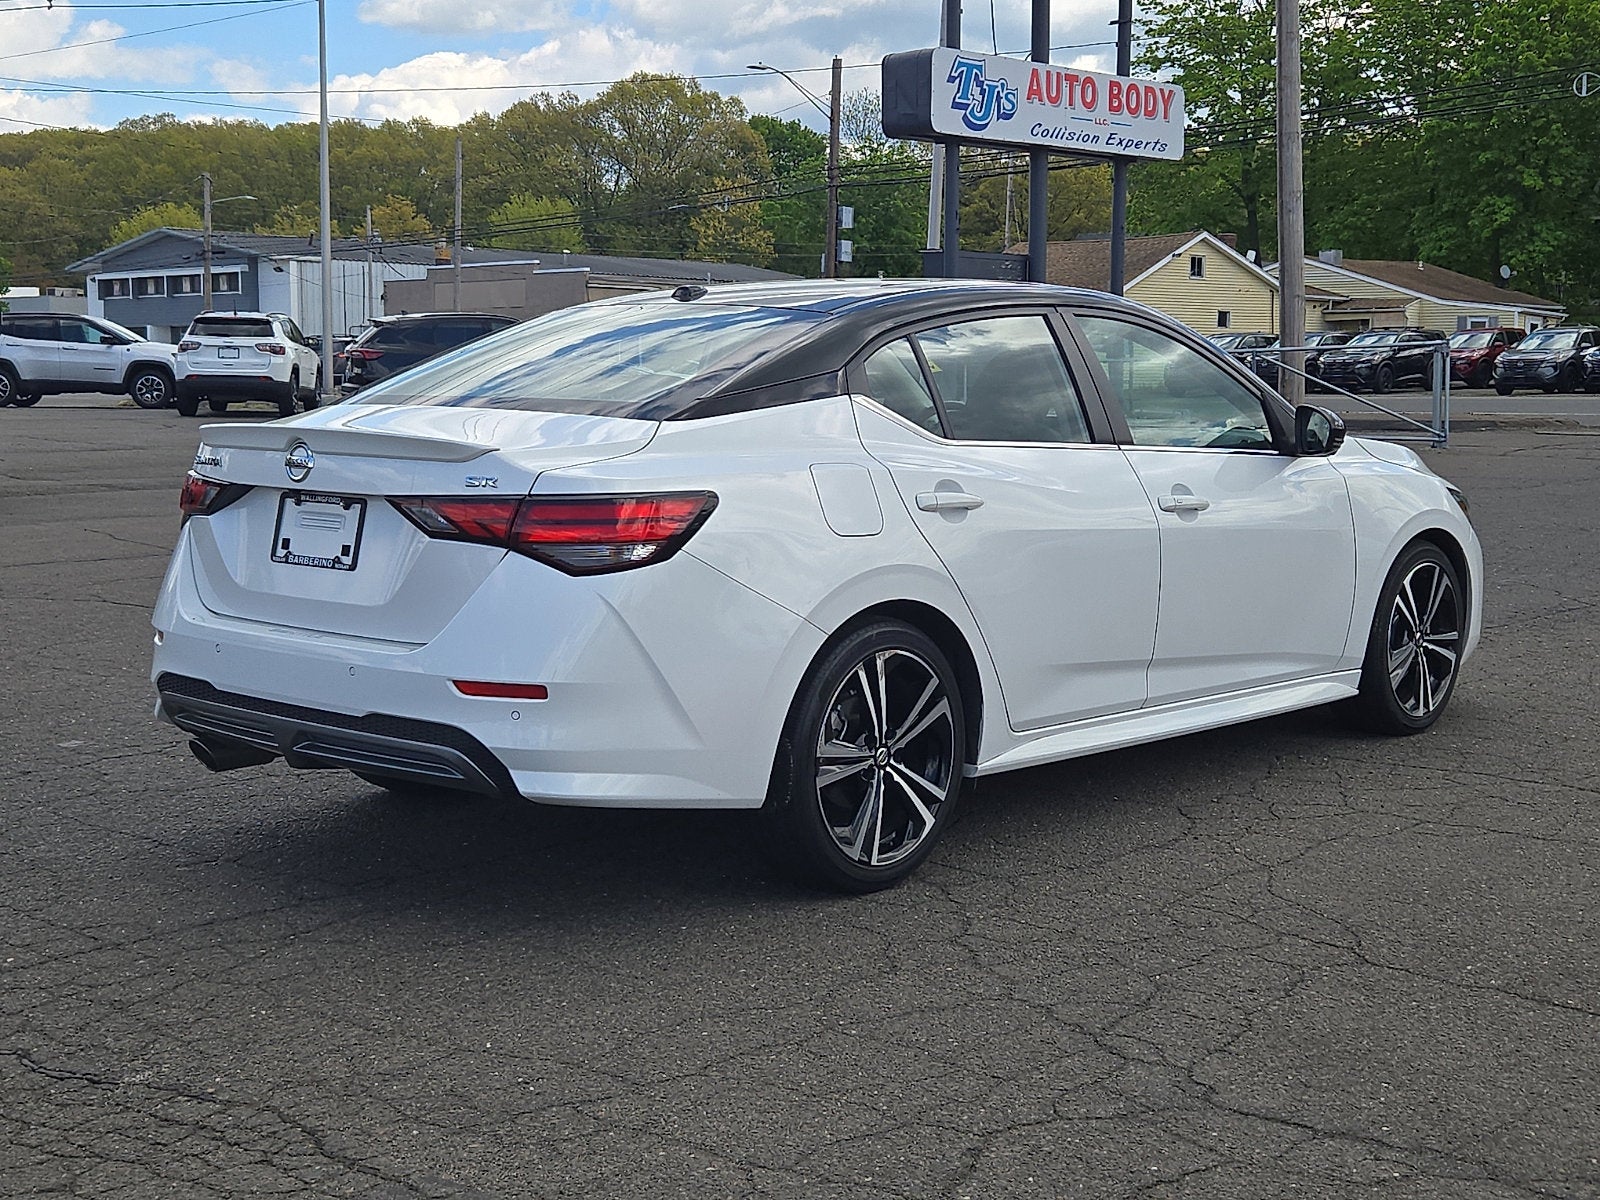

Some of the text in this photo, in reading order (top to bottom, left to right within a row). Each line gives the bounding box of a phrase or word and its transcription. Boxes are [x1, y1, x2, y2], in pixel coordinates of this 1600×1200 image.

[946, 55, 1175, 131] TJ's AUTO BODY
[1094, 117, 1110, 127] LLC.
[1030, 122, 1168, 152] Collision Experts
[465, 475, 498, 488] SR
[300, 494, 341, 504] WALLINGFORD
[288, 555, 333, 568] BARBERINO
